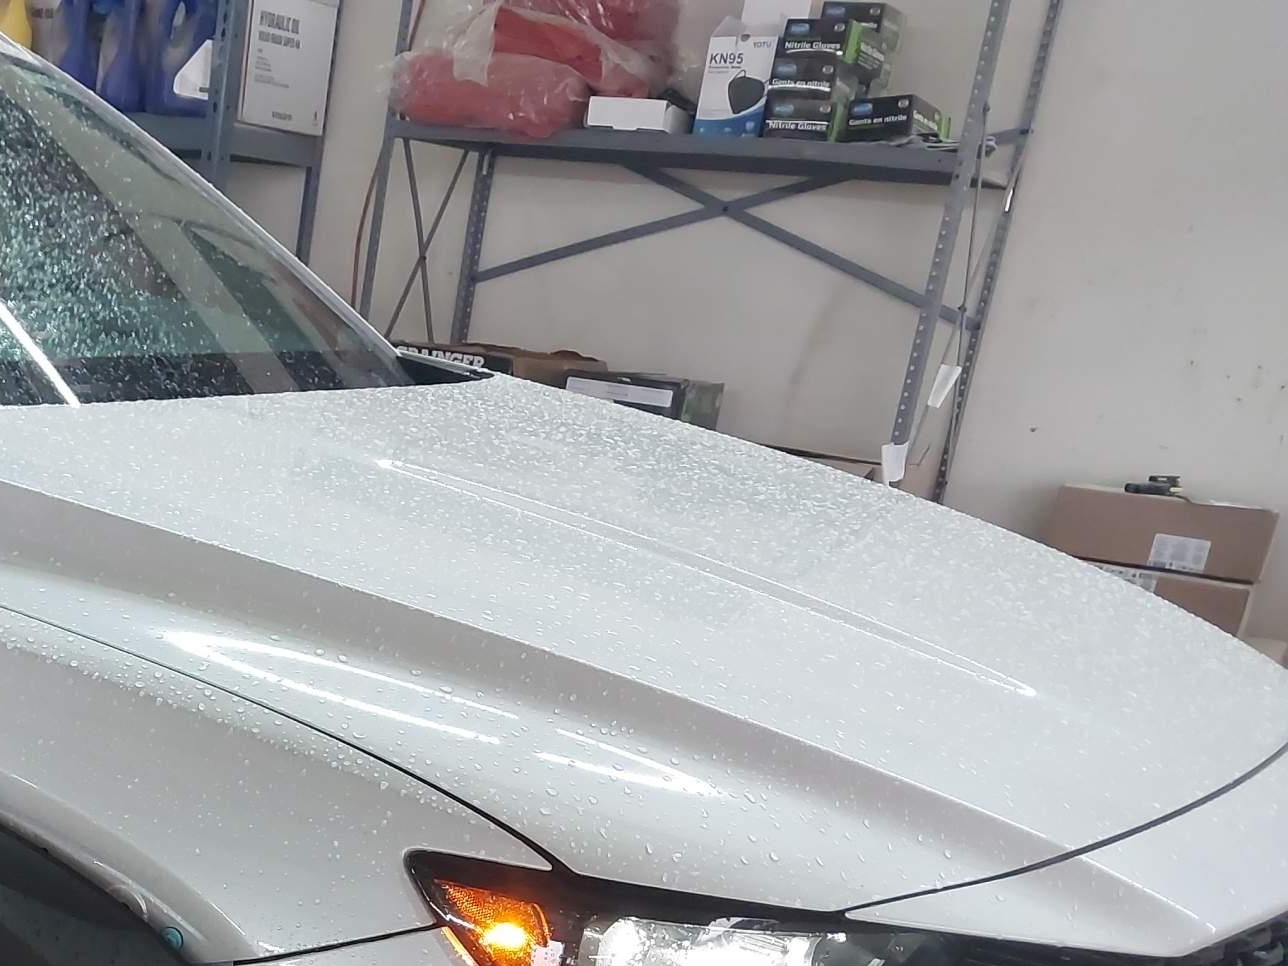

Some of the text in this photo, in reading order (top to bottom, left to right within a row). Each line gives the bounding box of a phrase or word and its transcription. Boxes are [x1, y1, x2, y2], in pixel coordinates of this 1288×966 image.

[784, 41, 841, 50] Nitrile Gloves
[709, 52, 744, 65] KN95
[884, 114, 908, 122] nitrile
[767, 121, 827, 131] Nitrile Gloves
